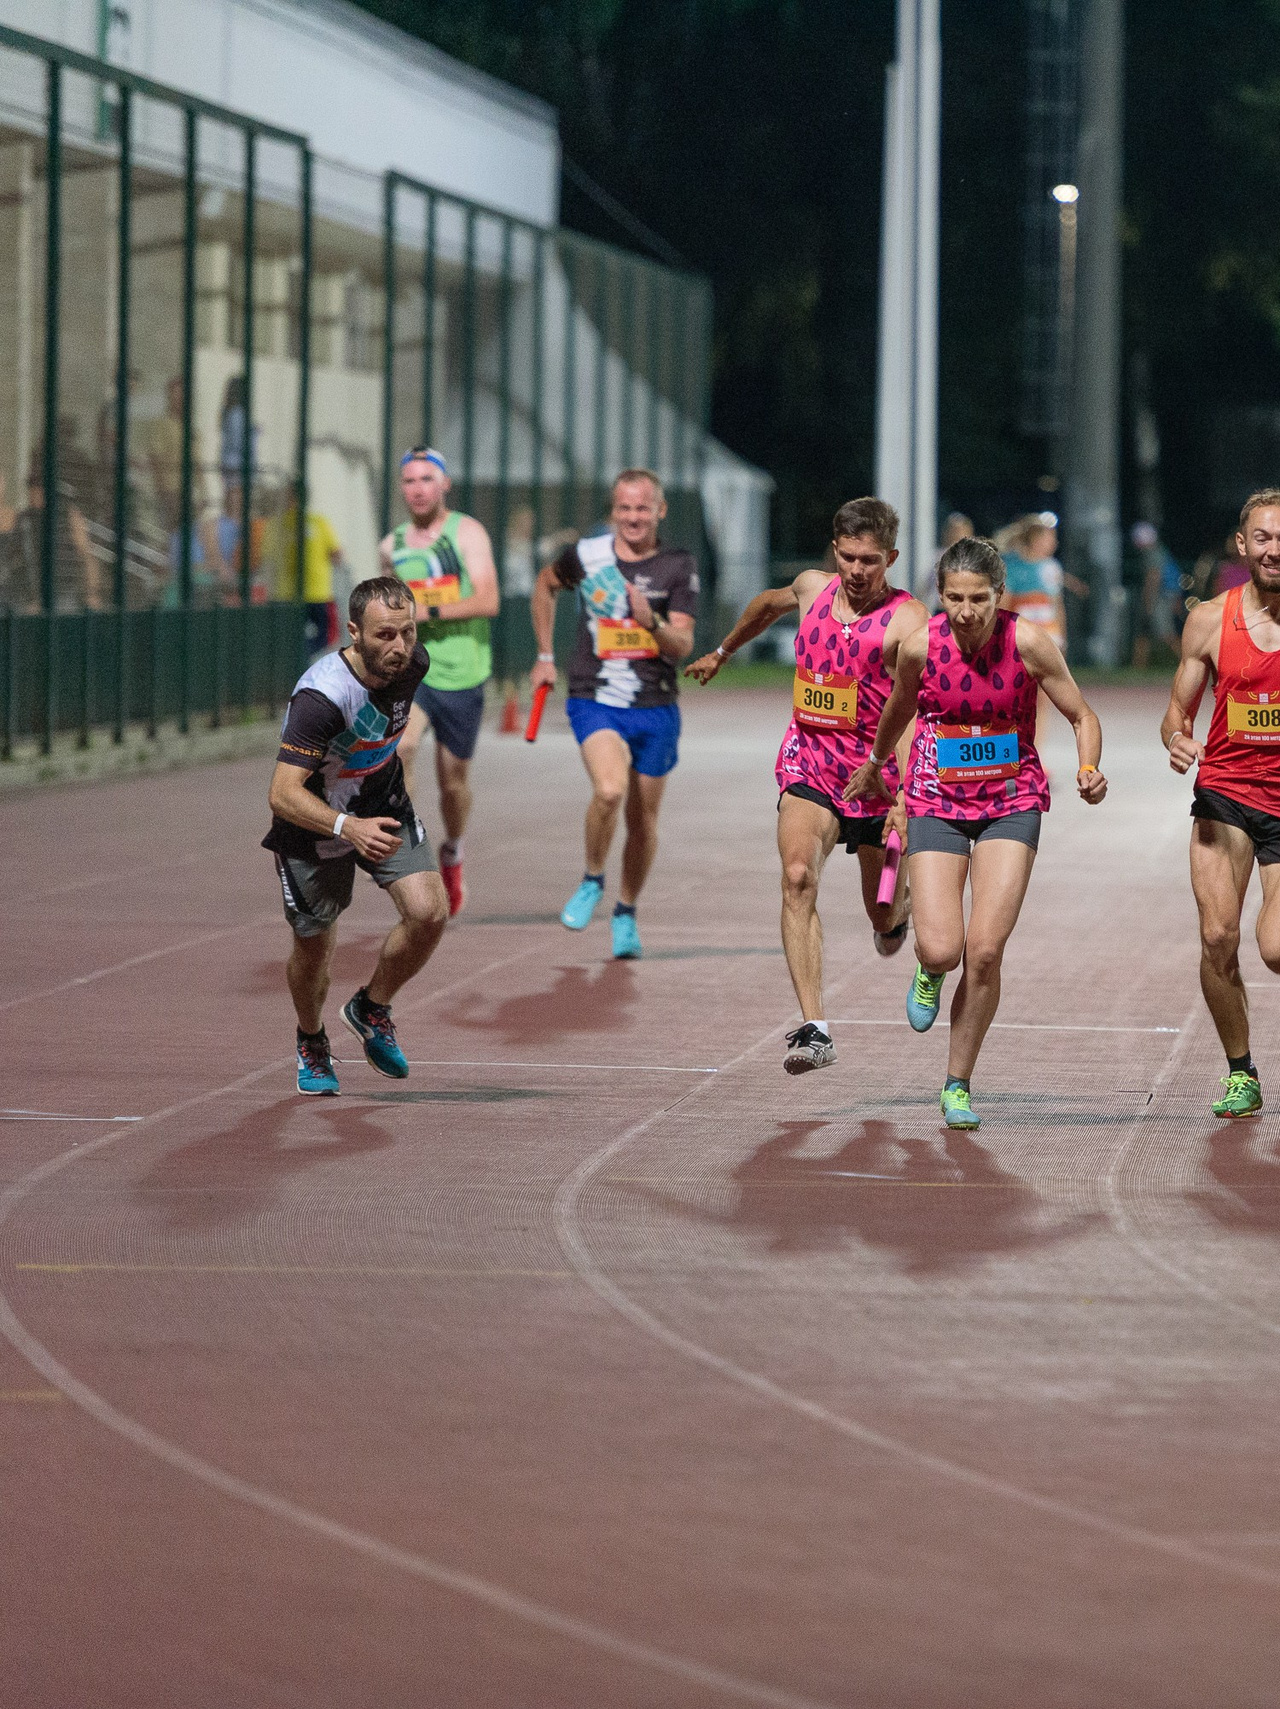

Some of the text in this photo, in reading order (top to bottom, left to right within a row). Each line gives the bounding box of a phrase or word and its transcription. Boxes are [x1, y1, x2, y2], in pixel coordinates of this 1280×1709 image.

[804, 688, 848, 711] 309 2
[960, 742, 1010, 762] 309 3
[975, 769, 984, 777] 100
[984, 768, 1002, 776] метров
